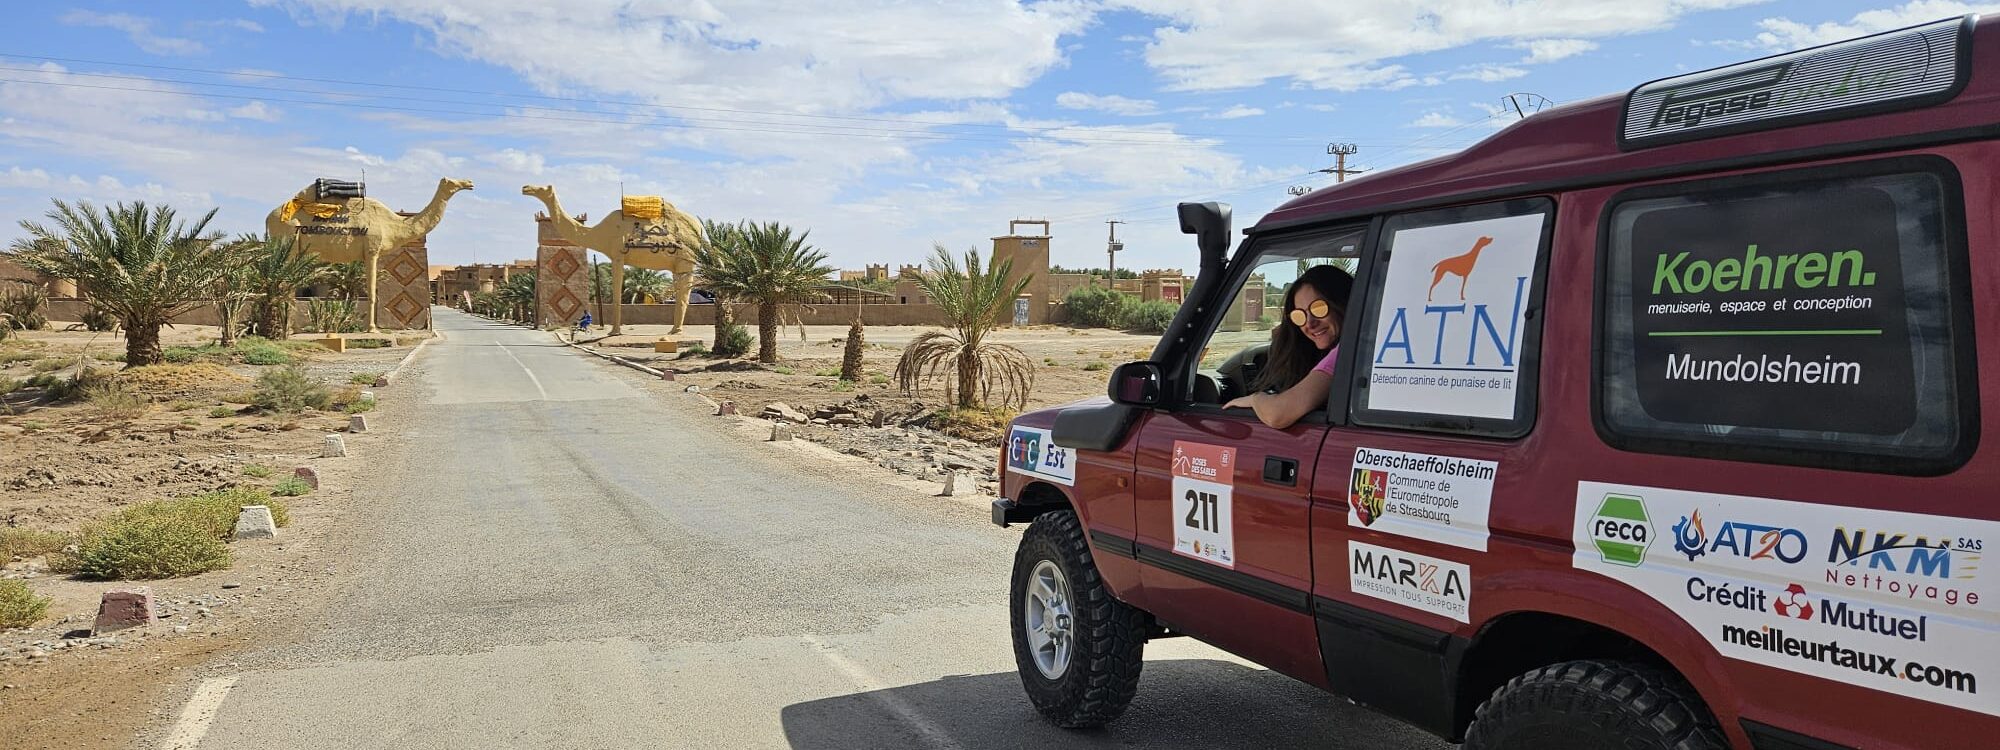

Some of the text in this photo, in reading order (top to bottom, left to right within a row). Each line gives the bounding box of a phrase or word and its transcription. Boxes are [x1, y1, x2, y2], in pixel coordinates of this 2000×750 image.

[1652, 244, 1876, 295] Koehren.
[1648, 295, 1872, 315] menuiserie, espace et conception
[1375, 277, 1527, 366] ATN
[1373, 373, 1511, 389] Détection canine de punaise de lit
[1665, 353, 1860, 384] Mundolsheim
[1045, 444, 1066, 469] Est
[1192, 457, 1207, 467] ROSES
[1356, 449, 1494, 480] Oberschaeffolsheim
[1387, 487, 1459, 509] l'Eurométropole
[1389, 473, 1450, 492] Commune de
[1185, 489, 1218, 533] 211
[1386, 502, 1450, 525] de Strasbourg
[1594, 519, 1647, 542] reca
[1958, 537, 1982, 550] SAS
[1828, 527, 1950, 579] NKM
[1354, 549, 1465, 601] MARKA
[1826, 568, 1979, 605] Nettoyage
[1354, 579, 1465, 614] IMPRESSION TOUS SUPPORTS
[1686, 576, 1926, 642] Crédit Mutuel
[1722, 624, 1977, 694] meilleurtaux.com
